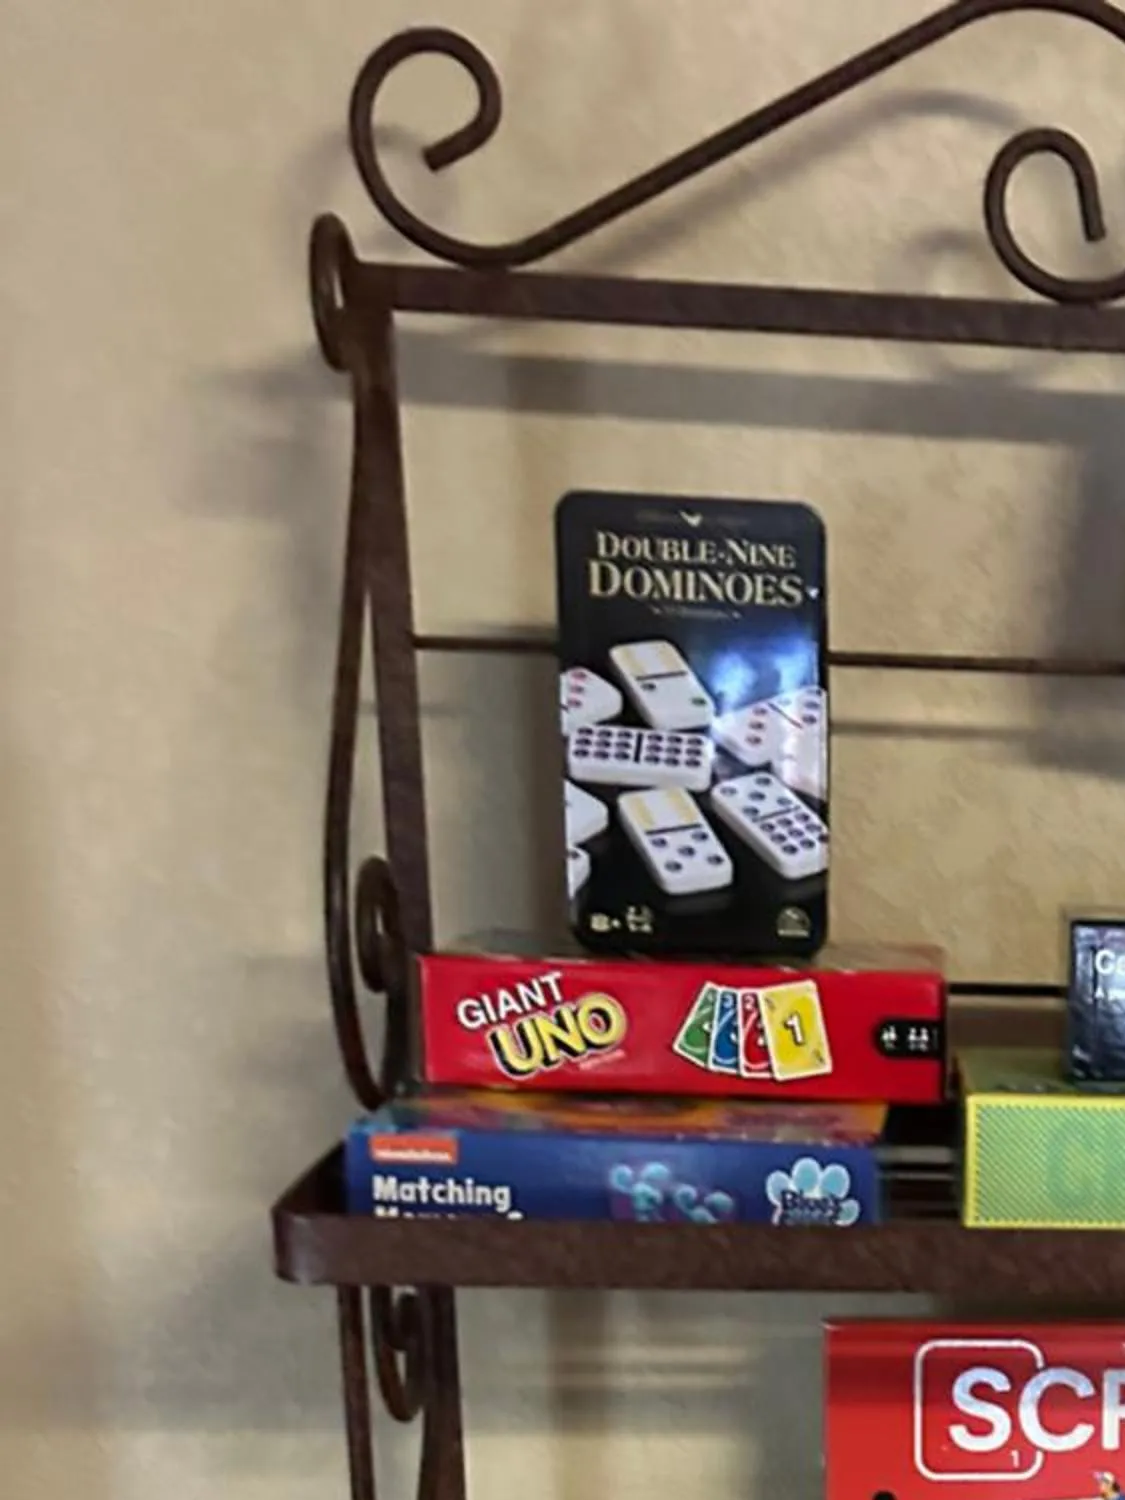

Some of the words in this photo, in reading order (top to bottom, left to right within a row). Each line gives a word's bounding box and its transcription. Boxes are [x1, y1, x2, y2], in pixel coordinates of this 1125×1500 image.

[588, 560, 804, 607] DOMINOES
[457, 970, 563, 1030] GIANT
[486, 992, 628, 1080] UNO
[783, 1012, 804, 1047] 1
[372, 1173, 512, 1213] Matching
